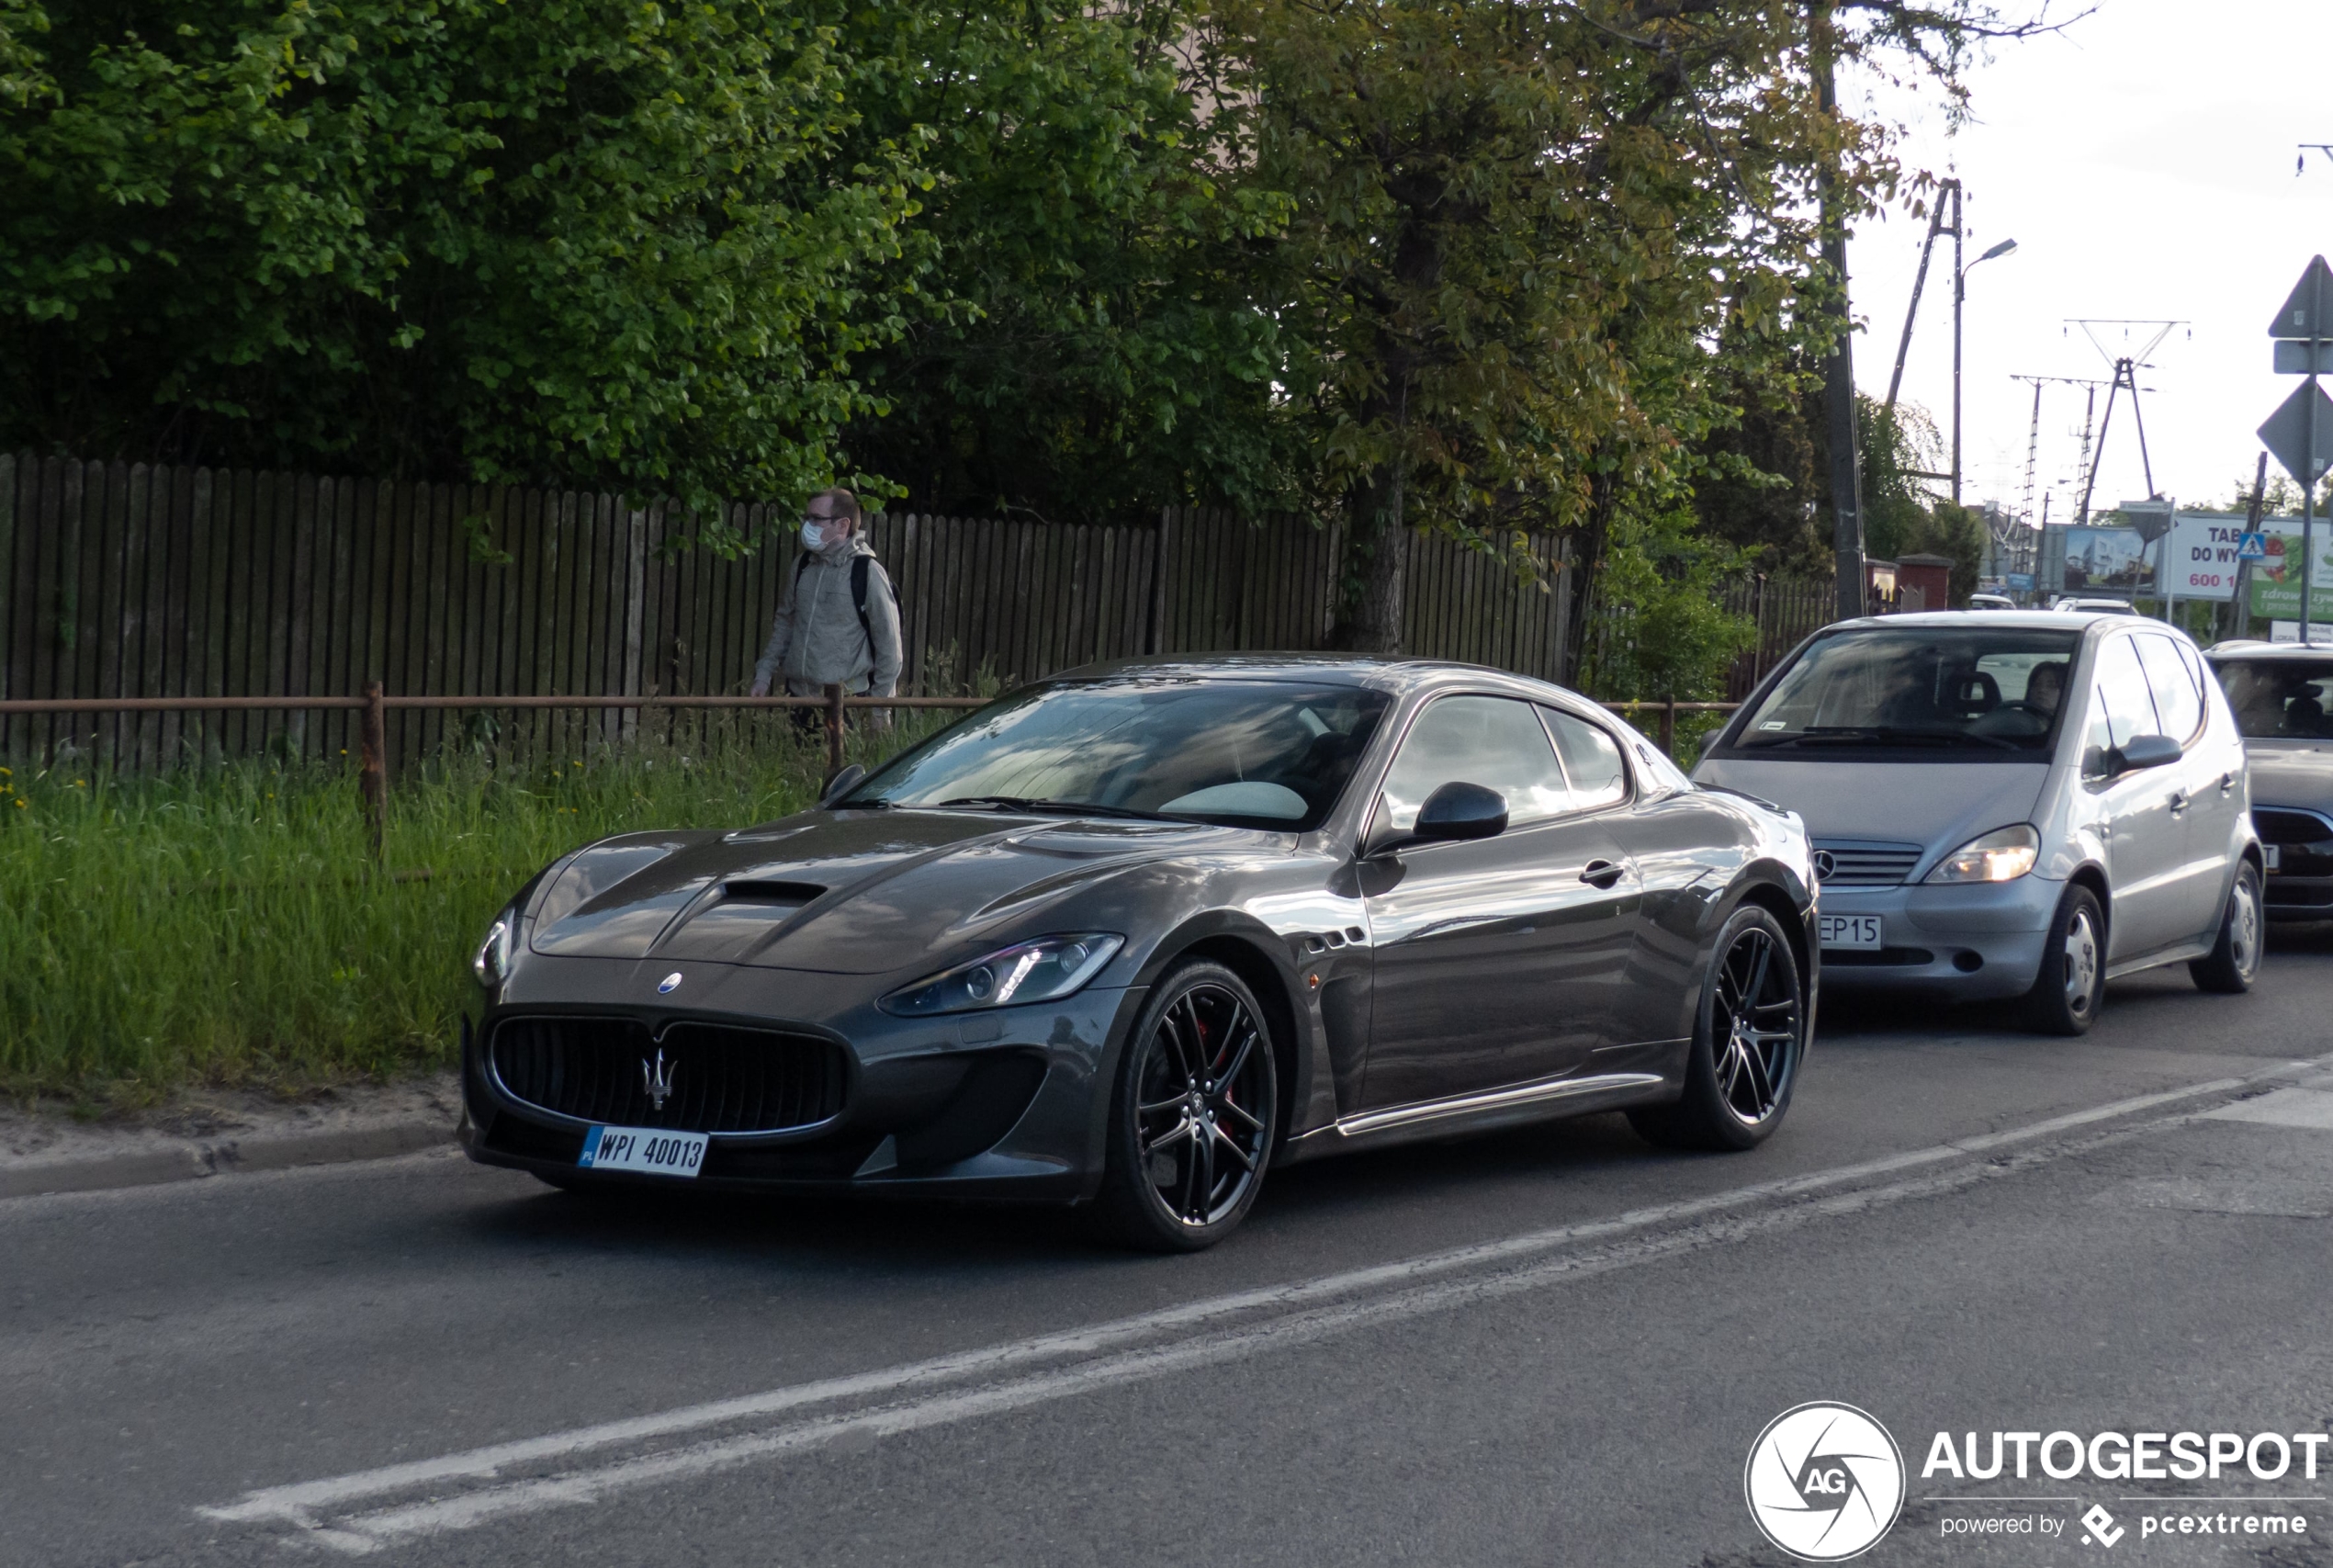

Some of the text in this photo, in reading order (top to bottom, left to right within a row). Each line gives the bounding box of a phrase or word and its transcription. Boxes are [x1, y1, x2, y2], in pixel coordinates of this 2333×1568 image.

[2192, 547, 2212, 561] DO
[2190, 573, 2220, 587] 600
[1820, 918, 1877, 942] EP15
[582, 1134, 703, 1168] PL WPI 40013
